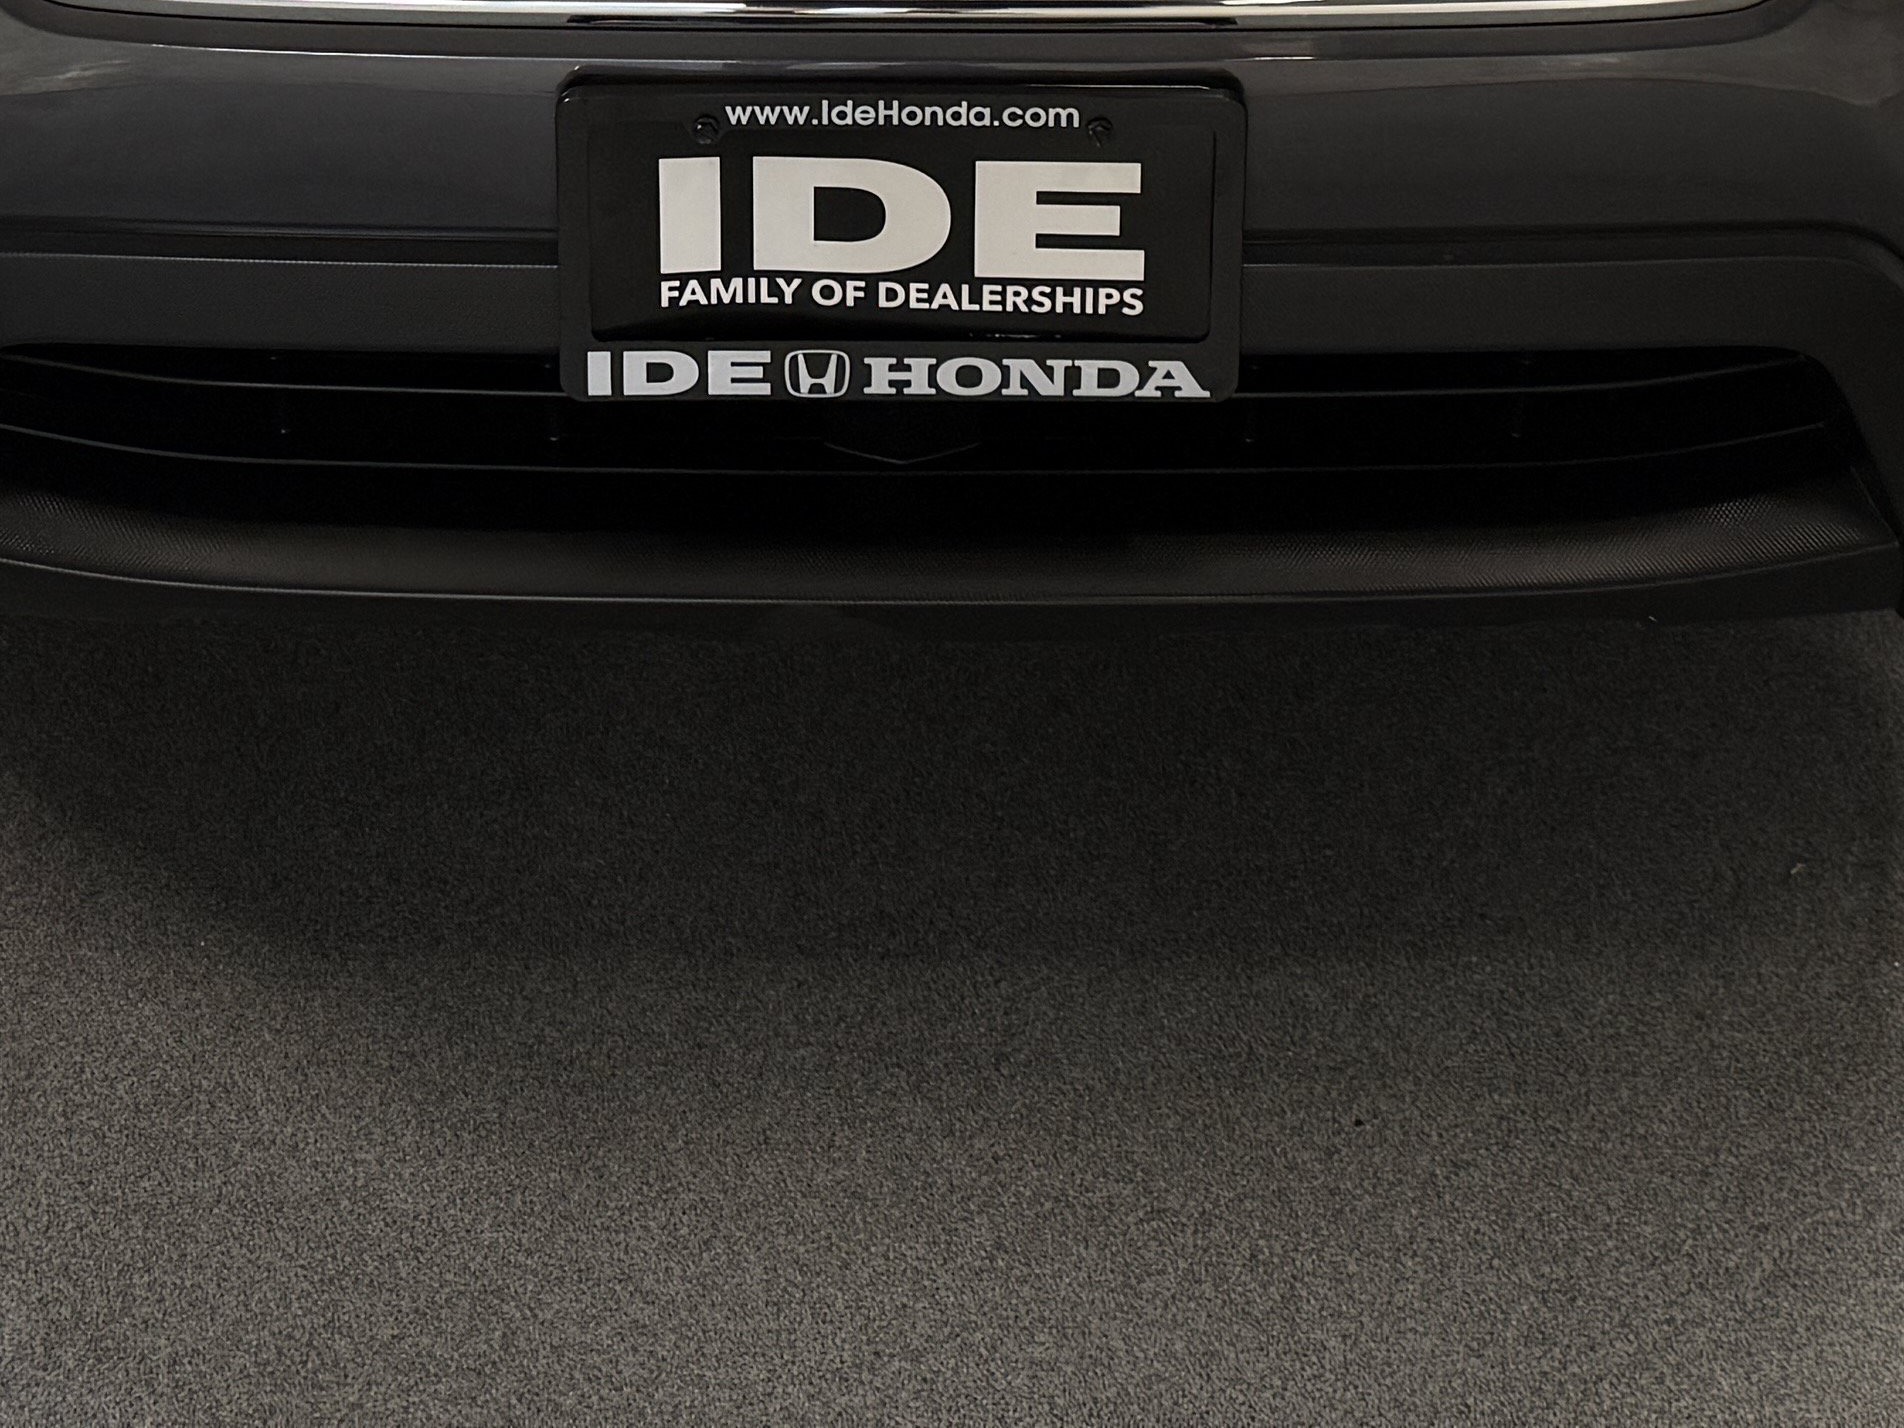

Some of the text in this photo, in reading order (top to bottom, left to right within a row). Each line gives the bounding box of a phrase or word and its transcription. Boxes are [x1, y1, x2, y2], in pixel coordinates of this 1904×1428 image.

[724, 99, 1081, 129] www.IdeHonda.com
[658, 155, 1146, 282] IDE
[659, 277, 1145, 316] FAMILY OF DEALERSHIPS
[586, 350, 1211, 398] IDE HONDA
